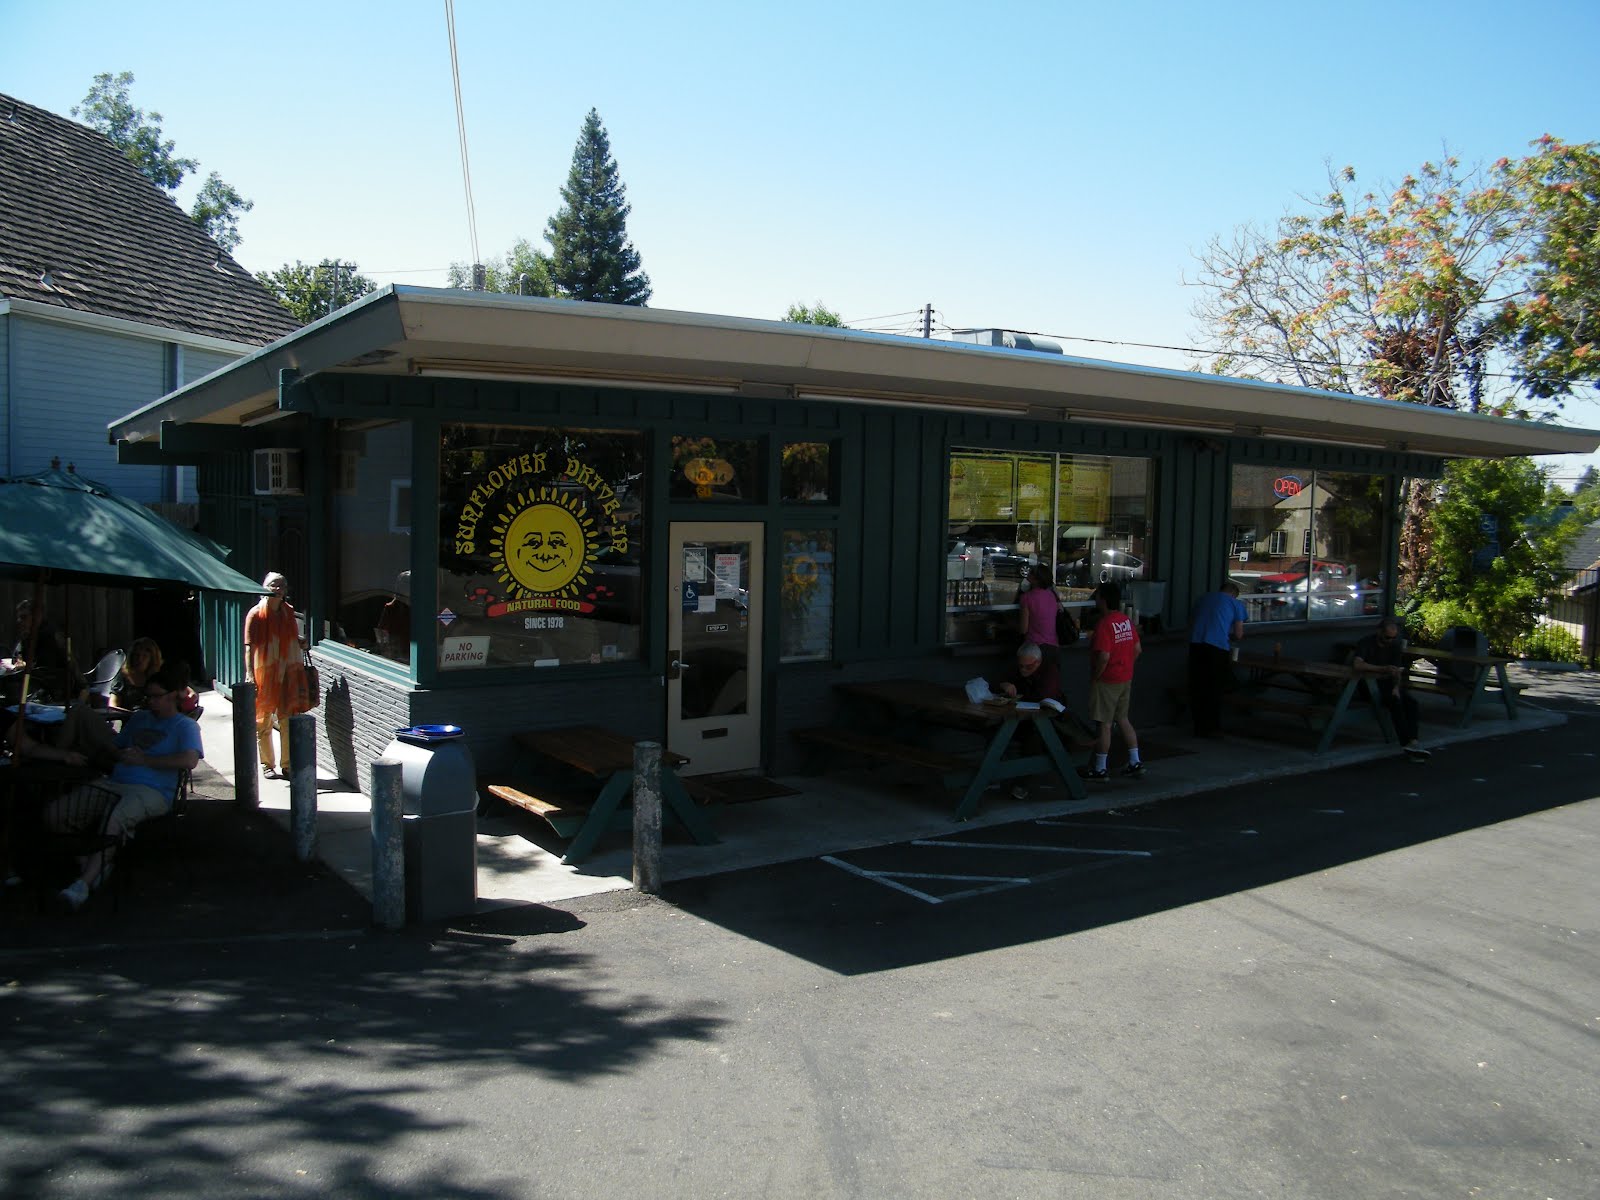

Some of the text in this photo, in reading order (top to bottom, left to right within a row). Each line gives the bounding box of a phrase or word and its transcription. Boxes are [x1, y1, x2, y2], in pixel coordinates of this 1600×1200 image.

[1274, 478, 1301, 496] OPEN
[455, 452, 548, 555] SUNFLOWER
[506, 599, 581, 613] NATURAL FOOD
[524, 617, 564, 630] SINCE 1978
[458, 642, 473, 652] NO
[444, 652, 484, 662] PARKING
